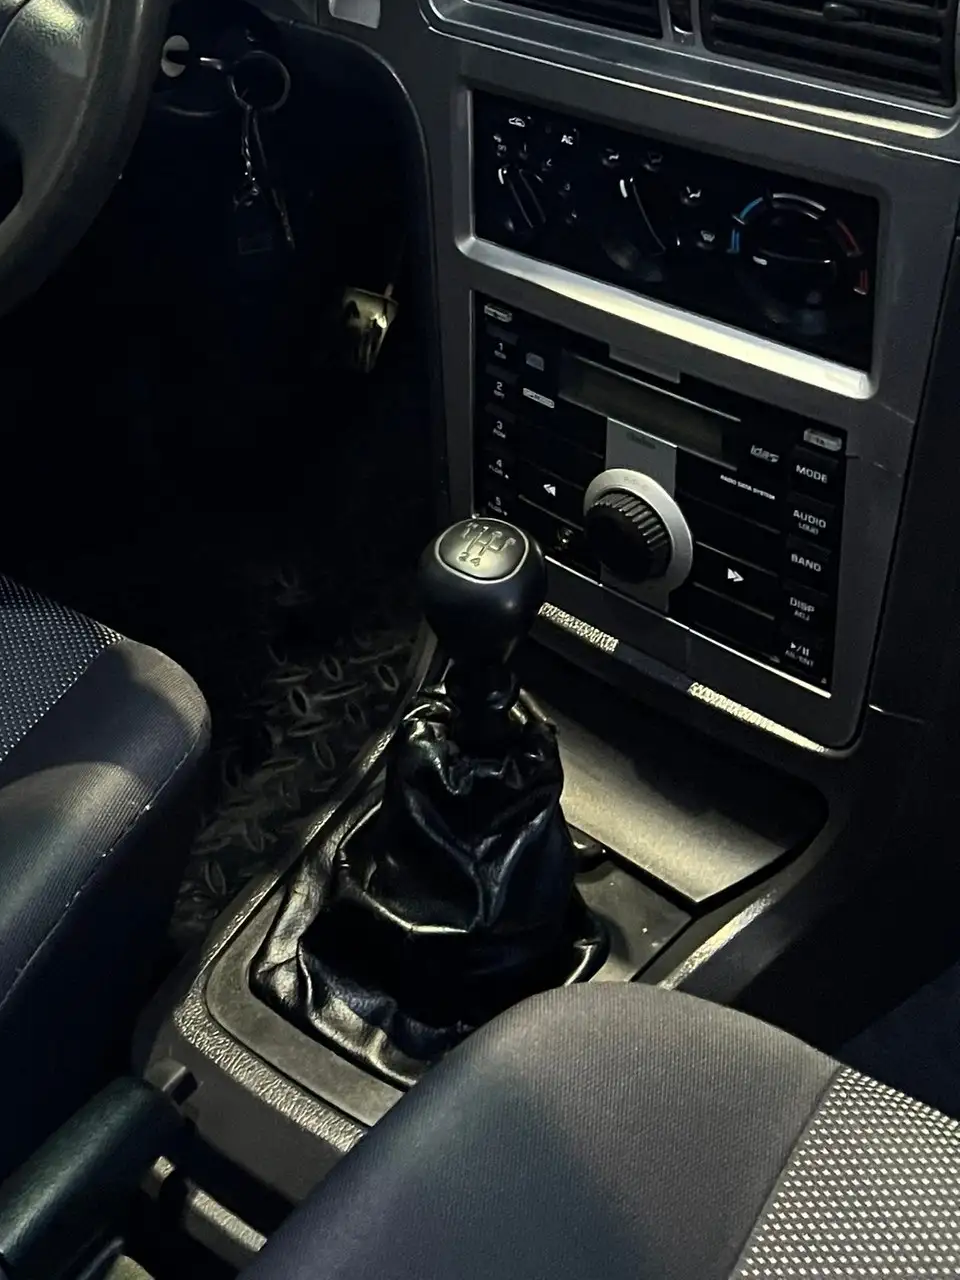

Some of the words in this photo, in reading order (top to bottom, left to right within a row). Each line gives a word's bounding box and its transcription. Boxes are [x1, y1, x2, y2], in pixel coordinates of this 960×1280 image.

[496, 381, 503, 391] 2
[496, 420, 503, 430] 3
[796, 464, 828, 483] MODE
[793, 509, 827, 529] AUDIO
[457, 551, 470, 562] 2
[469, 557, 481, 567] 4
[790, 553, 822, 573] BAND
[789, 596, 815, 613] DISP
